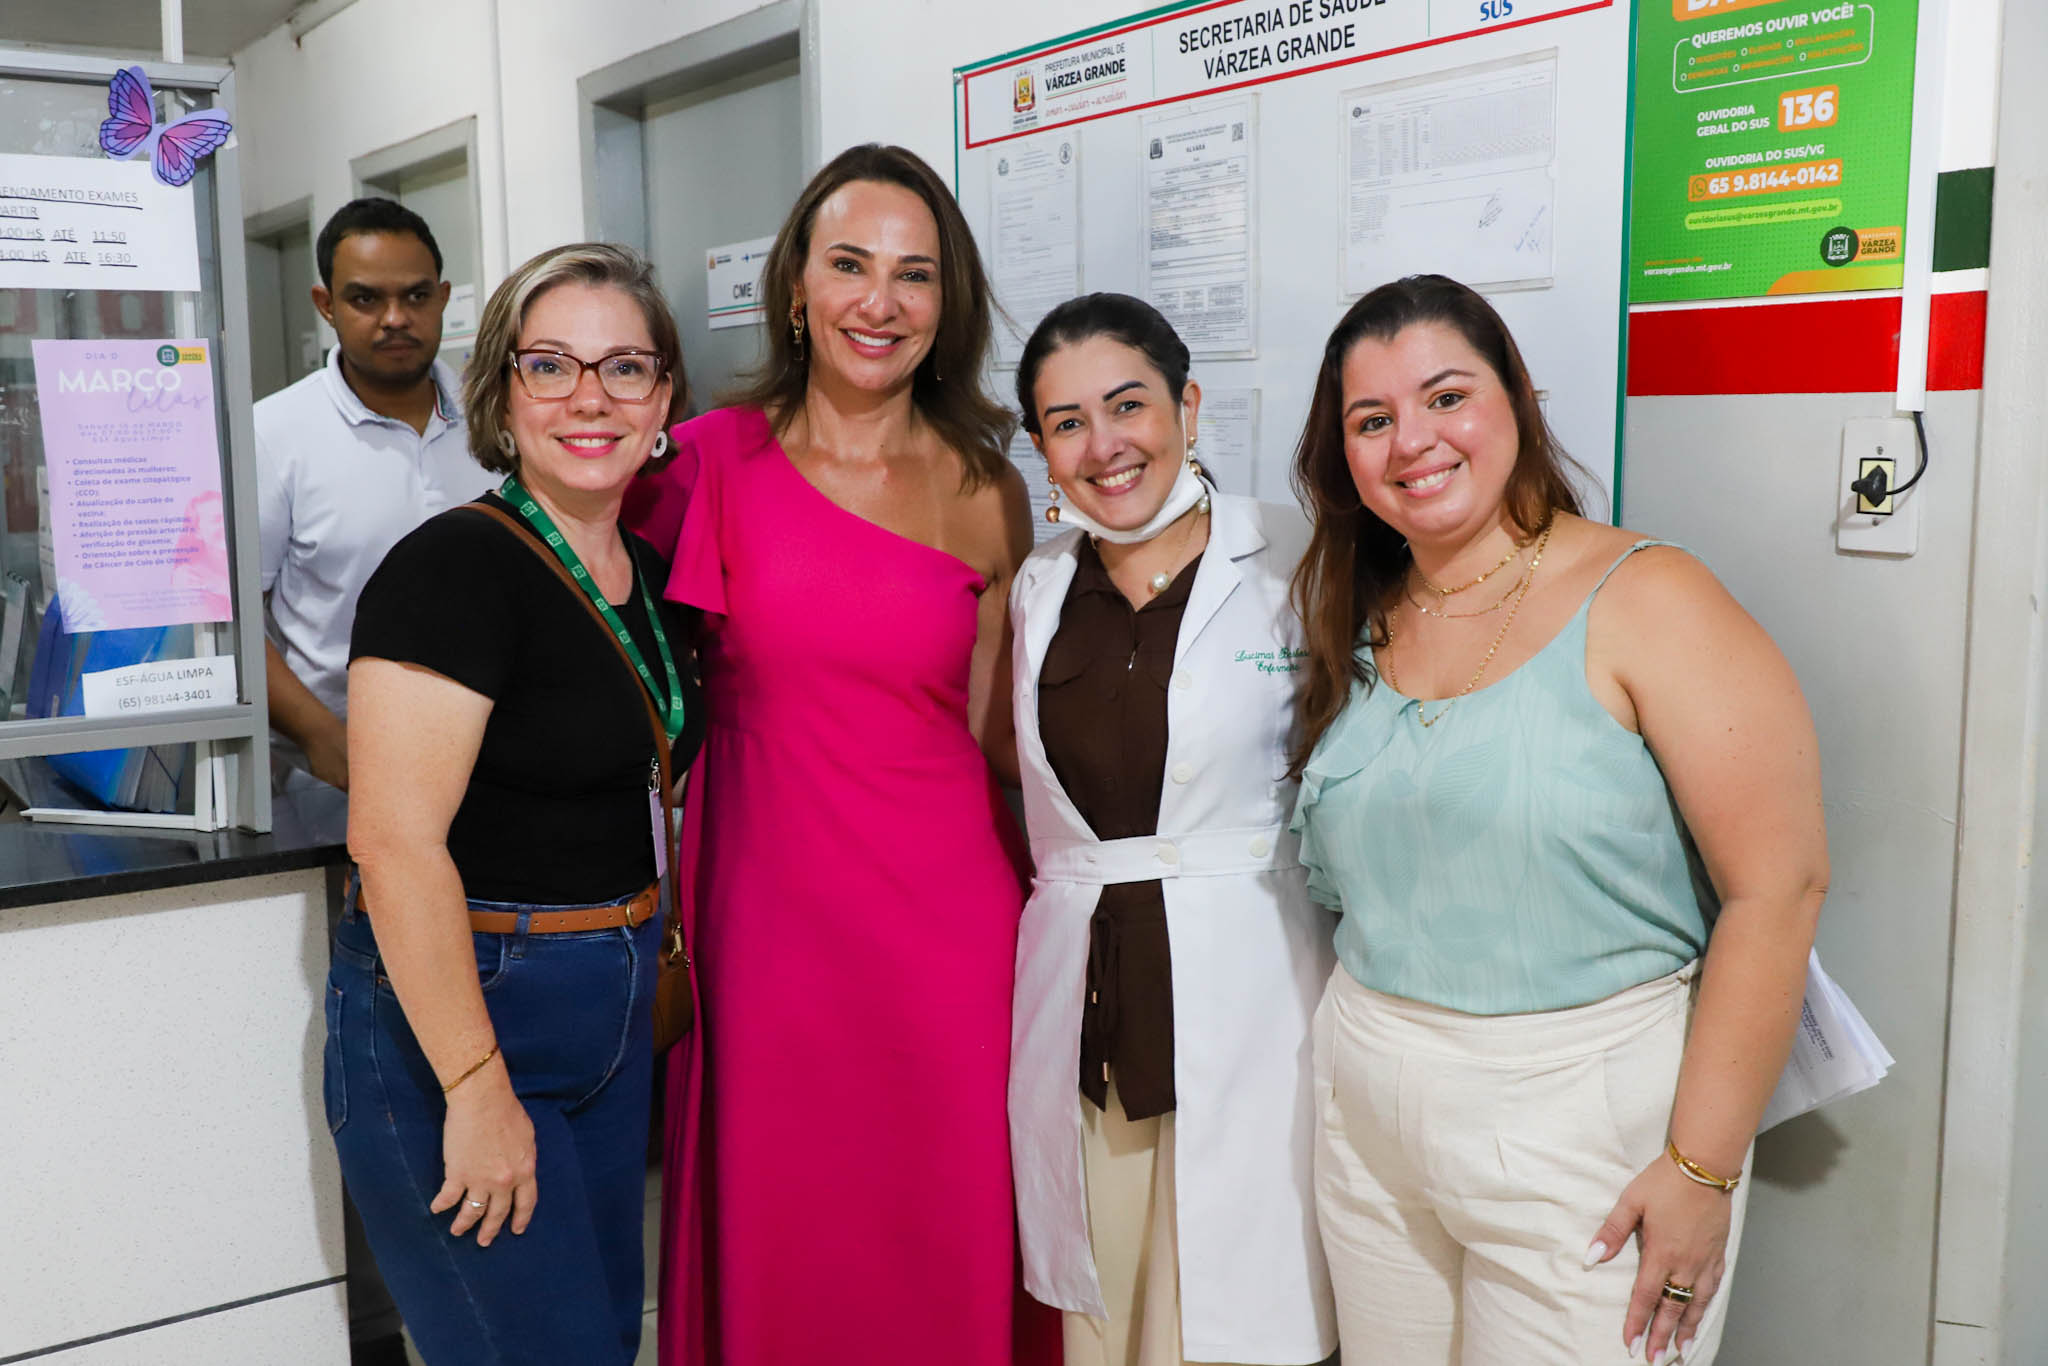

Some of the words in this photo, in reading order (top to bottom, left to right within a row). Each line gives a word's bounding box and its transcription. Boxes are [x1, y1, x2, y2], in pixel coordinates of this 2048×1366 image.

[1179, 7, 1284, 54] SECRETARIA
[1290, 1, 1313, 27] DE
[1692, 22, 1763, 48] QUEREMOS
[1765, 14, 1808, 33] OUVIR
[1811, 2, 1854, 24] VOCÊ!
[1045, 55, 1080, 72] PREFEITURA
[1081, 45, 1115, 62] MUNICIPAL
[1116, 42, 1126, 55] DE
[1204, 45, 1272, 80] VÁRZEA
[1277, 24, 1355, 63] GRANDE
[1045, 70, 1082, 92] VÁRZEA
[1084, 58, 1126, 81] GRANDE
[1697, 104, 1755, 122] OUVIDORIA
[1782, 90, 1834, 126] 136
[1696, 123, 1730, 137] GERAL
[1731, 121, 1747, 132] DO
[1750, 117, 1770, 130] SUS
[1705, 152, 1763, 169] OUVIDORIA
[1765, 149, 1782, 161] DO
[1784, 143, 1825, 160] SUS/VG
[1708, 176, 1730, 195] 65
[1733, 163, 1839, 193] 9.8144-0142
[88, 190, 138, 202] EXAMES
[26, 228, 43, 238] HS
[93, 231, 127, 242] 11:50
[1861, 238, 1896, 248] VÁRZEA
[32, 250, 48, 260] HS
[98, 252, 131, 263] 16:30
[1860, 246, 1896, 255] GRANDE
[85, 352, 106, 360] DIA
[177, 667, 213, 681] LIMPA
[118, 696, 141, 711] (65)
[144, 689, 212, 706] 98144-3401
